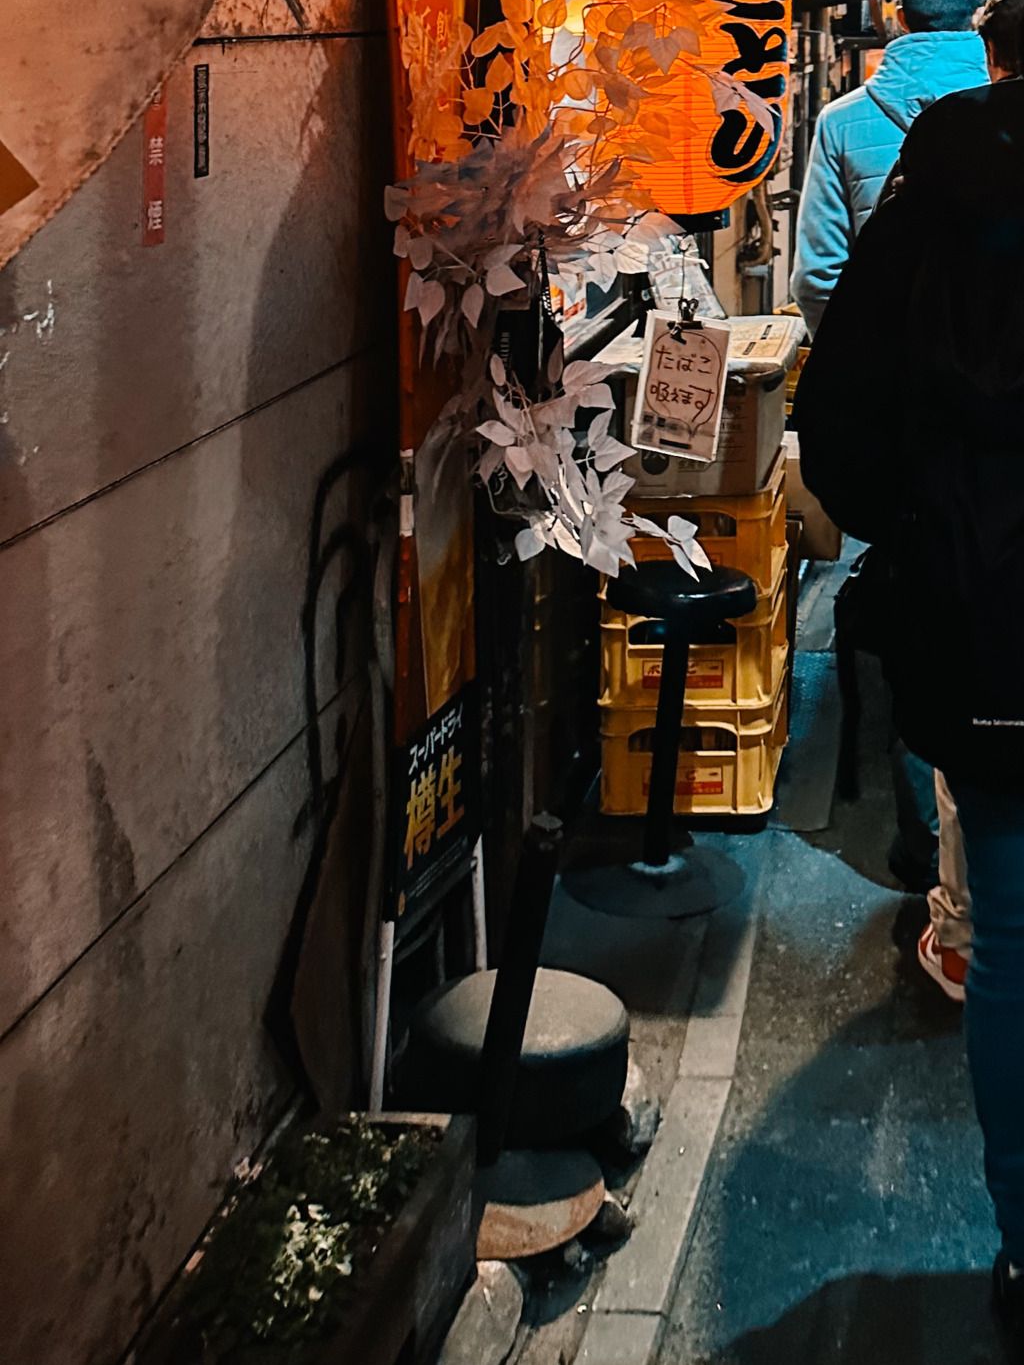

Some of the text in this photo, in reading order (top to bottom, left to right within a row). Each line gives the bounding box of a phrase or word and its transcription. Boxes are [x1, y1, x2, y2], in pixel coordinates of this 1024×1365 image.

[655, 344, 713, 375] たばこ
[649, 381, 716, 423] 吸えます
[408, 701, 464, 776] スーパードライ
[404, 745, 465, 871] 樽生
